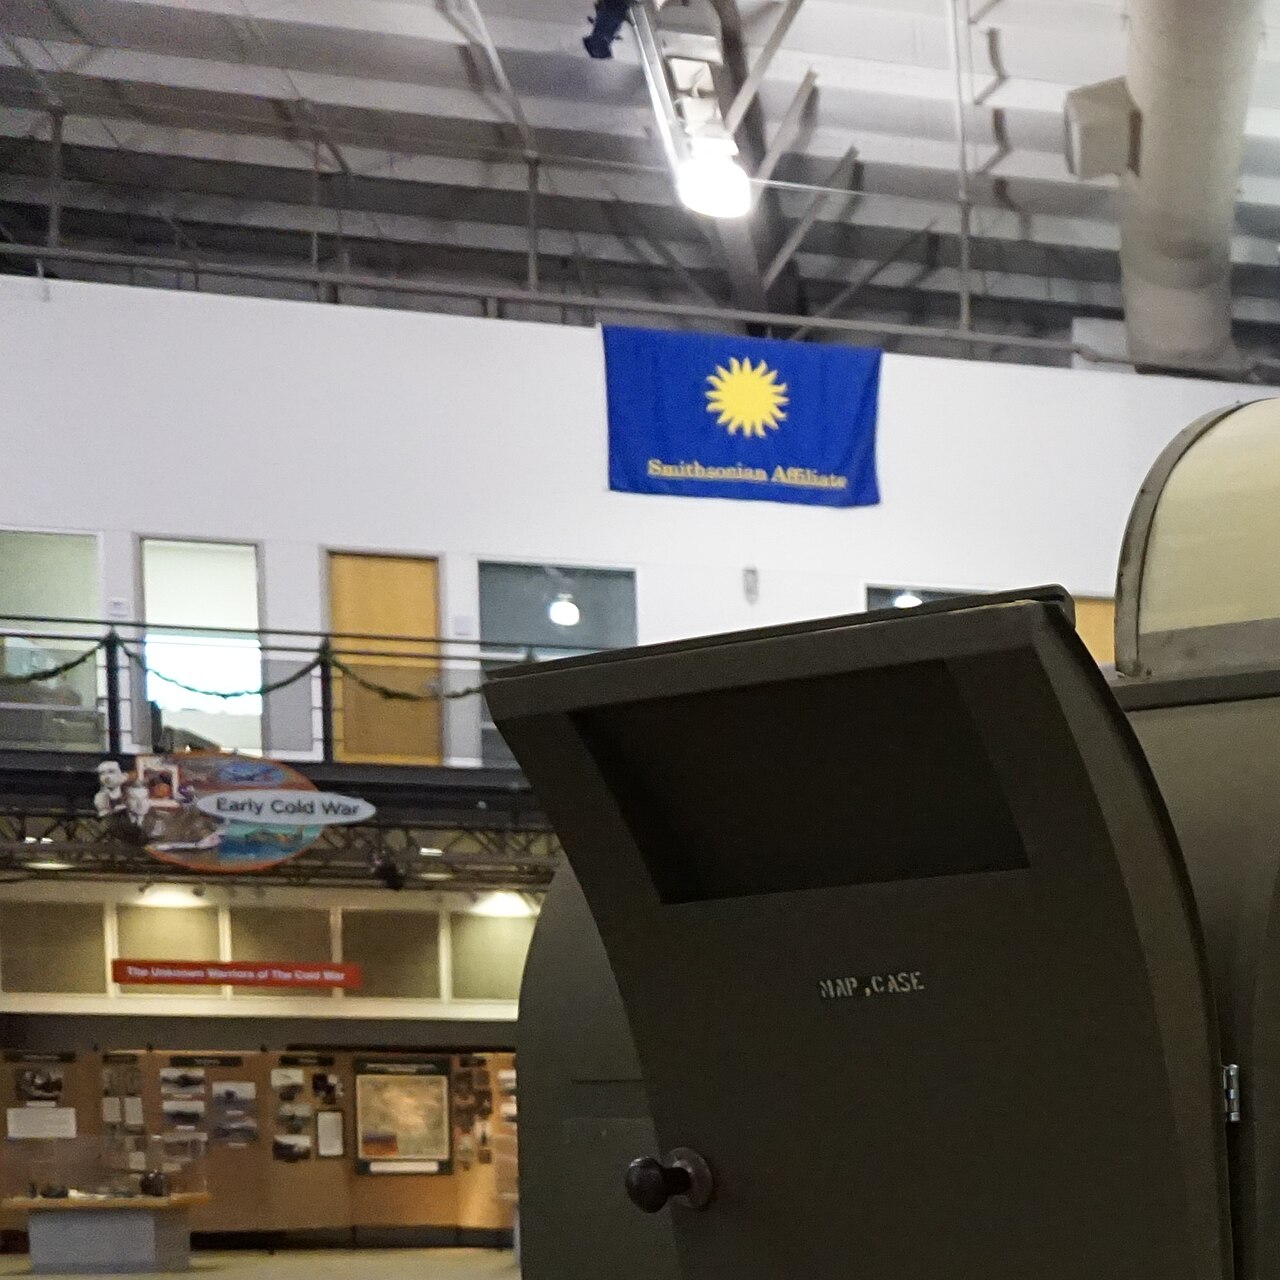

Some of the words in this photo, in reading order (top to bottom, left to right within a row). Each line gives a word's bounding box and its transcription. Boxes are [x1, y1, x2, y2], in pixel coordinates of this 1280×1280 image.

[648, 458, 767, 483] Smithsonian
[771, 464, 847, 489] Affiliate
[216, 798, 264, 816] Early
[271, 798, 314, 814] Cold
[321, 800, 360, 815] War
[870, 971, 925, 993] CASE
